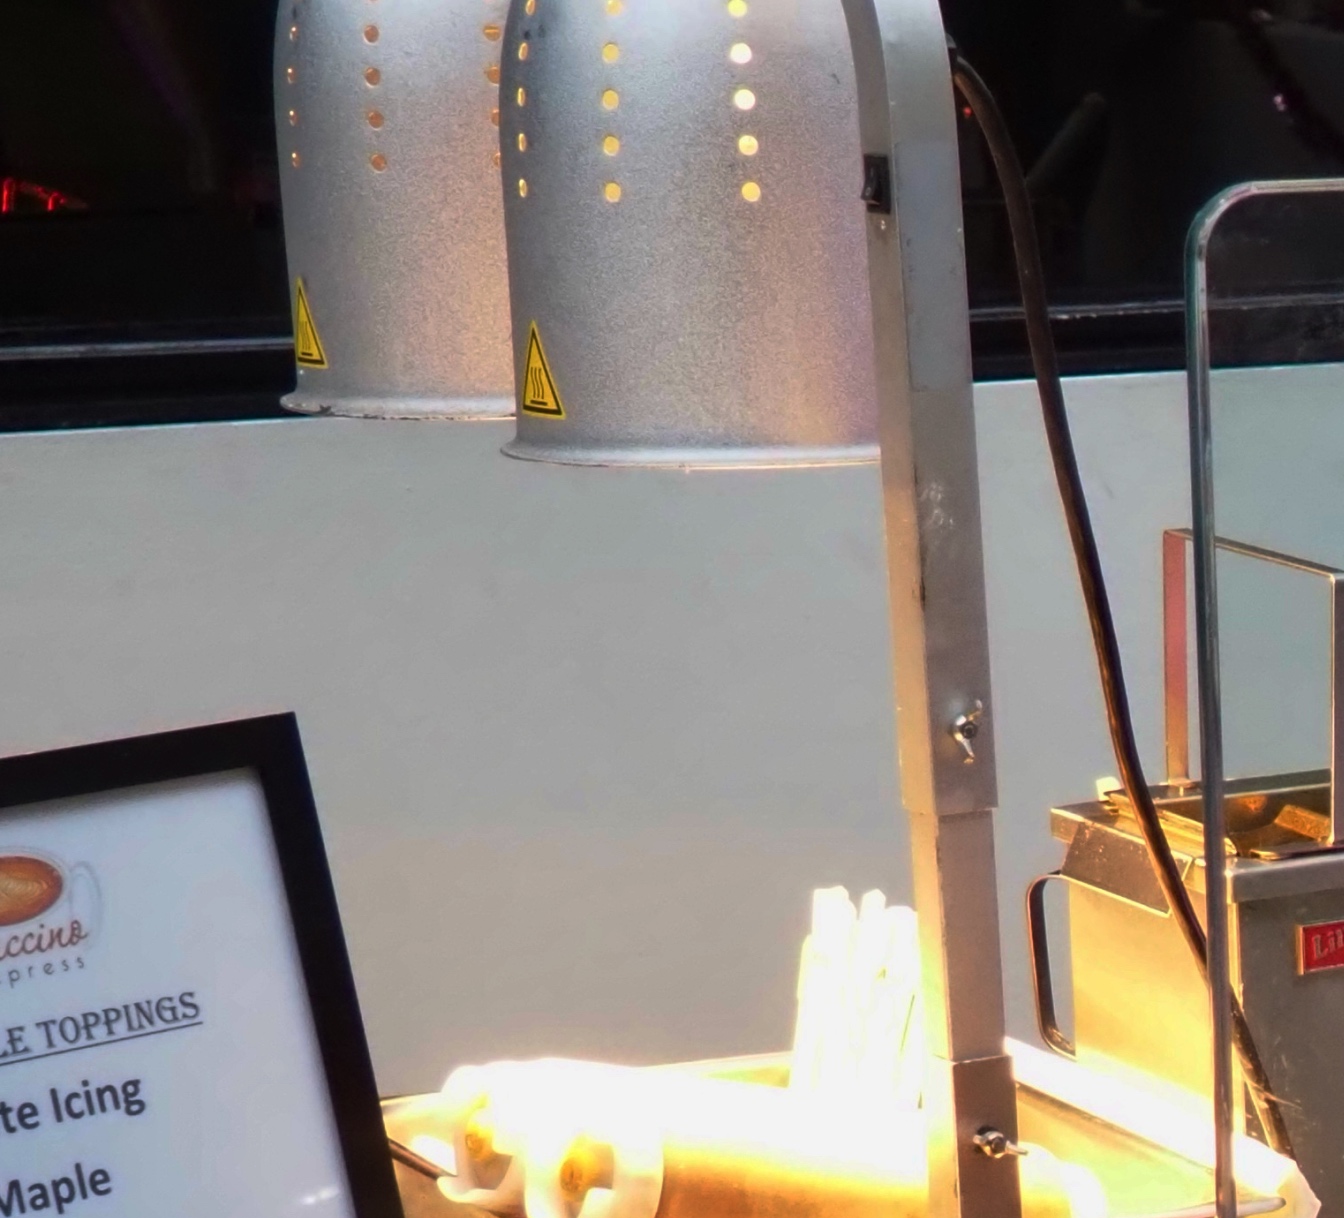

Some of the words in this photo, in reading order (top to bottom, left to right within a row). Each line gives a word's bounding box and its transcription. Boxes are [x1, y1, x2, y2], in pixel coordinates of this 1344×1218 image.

[0, 957, 86, 989] press
[0, 1026, 32, 1058] E
[35, 991, 201, 1049] TOPPINGS
[0, 1100, 41, 1134] te
[49, 1079, 146, 1117] Icing
[0, 1162, 113, 1218] Maple
